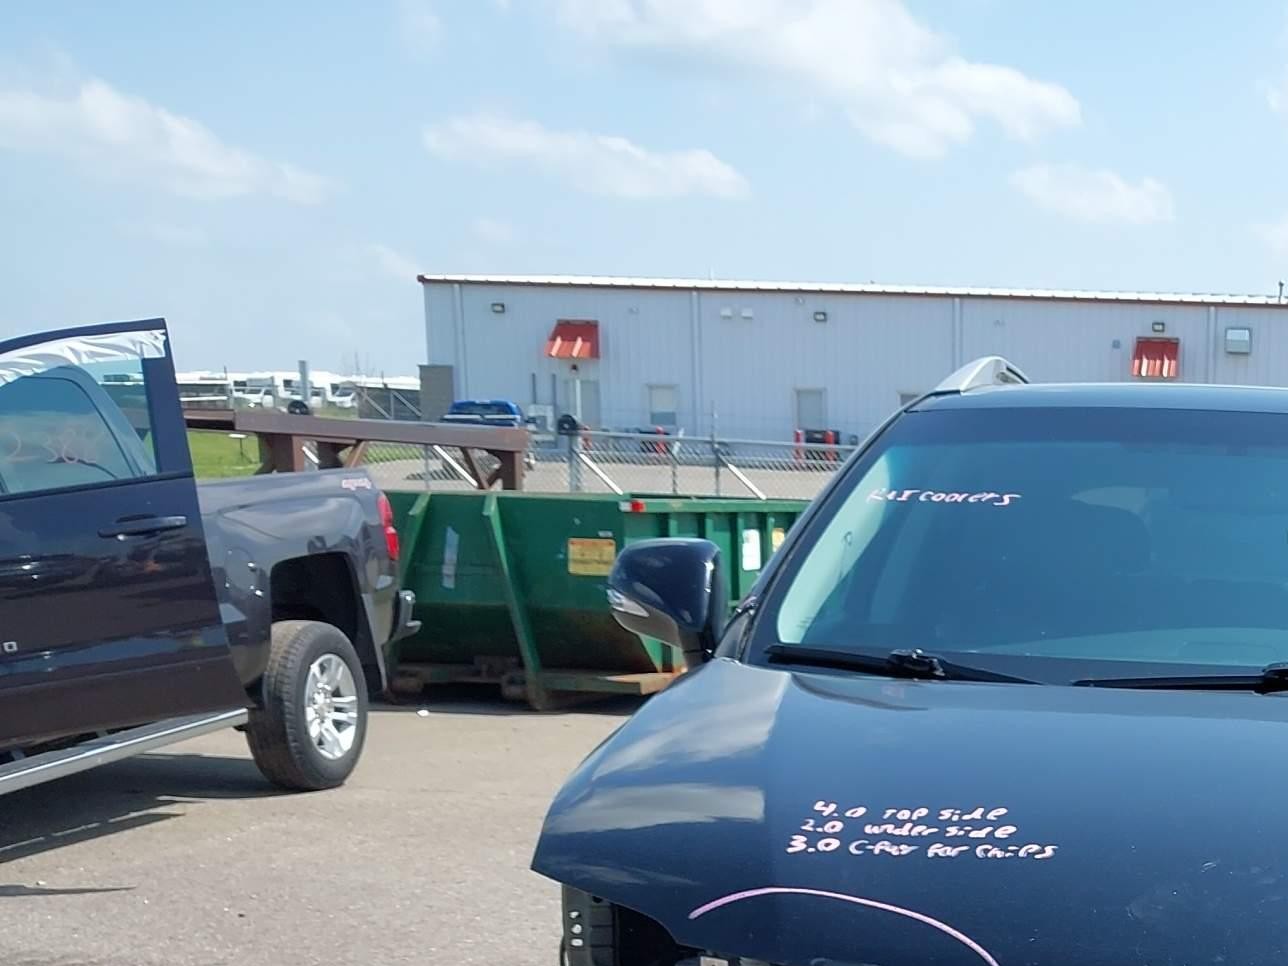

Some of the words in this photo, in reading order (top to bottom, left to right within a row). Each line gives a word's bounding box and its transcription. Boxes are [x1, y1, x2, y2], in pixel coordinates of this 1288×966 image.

[814, 800, 867, 817] 4.0
[800, 818, 844, 833] 2.0
[786, 835, 841, 853] 3.0
